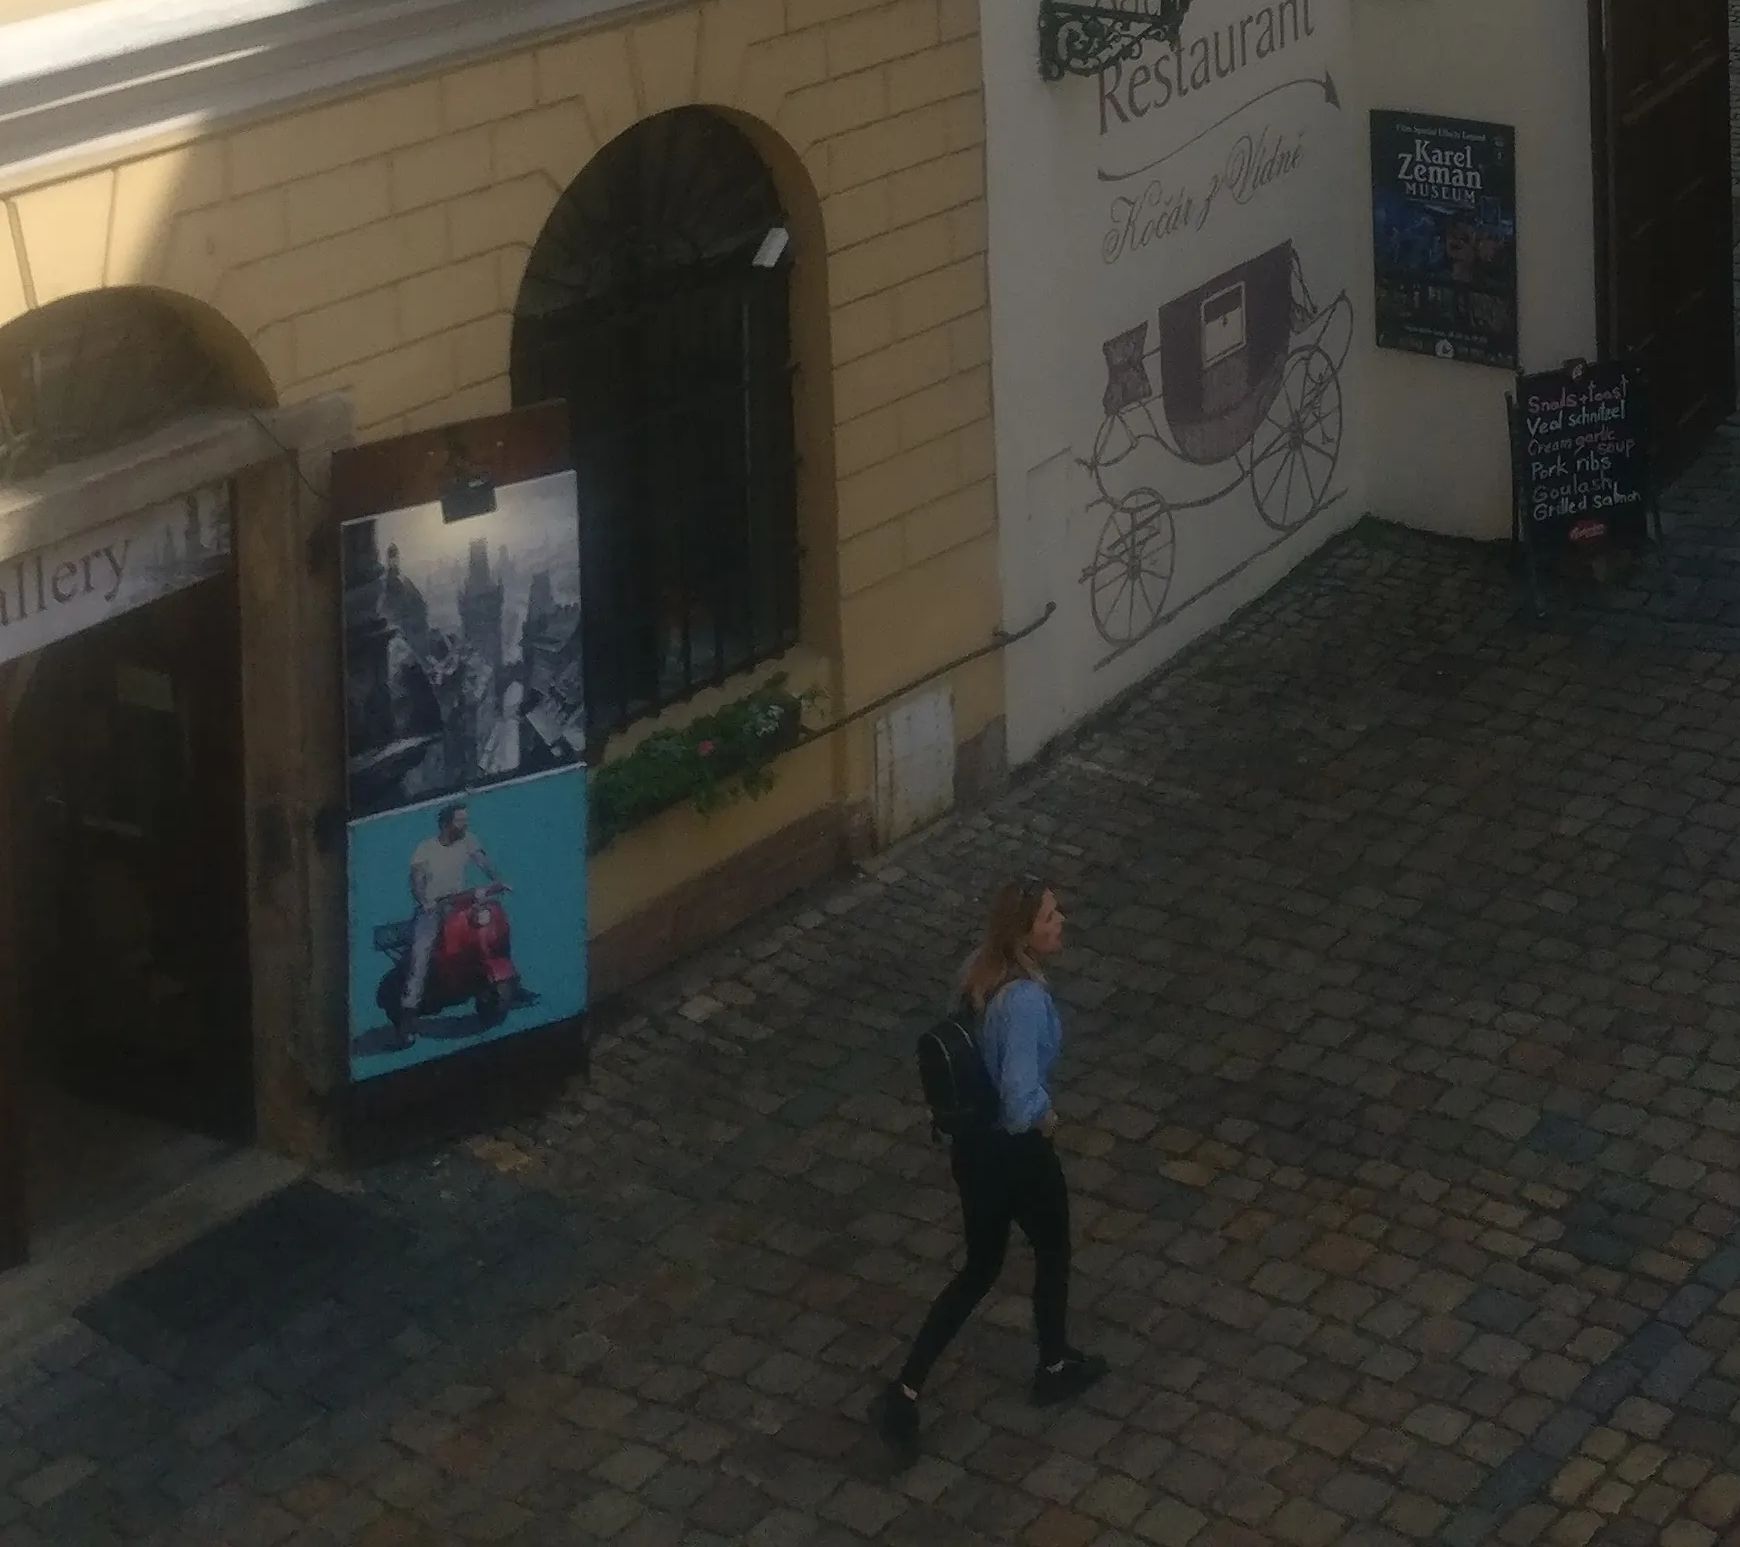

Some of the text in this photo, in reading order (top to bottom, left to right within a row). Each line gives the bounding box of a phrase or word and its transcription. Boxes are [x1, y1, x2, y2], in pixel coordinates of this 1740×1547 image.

[1414, 139, 1473, 168] Karel
[1397, 153, 1483, 190] Zeman
[1404, 182, 1476, 204] MUSEUM
[1526, 399, 1625, 436] Veal schnitzel
[1528, 438, 1572, 456] Cream
[1597, 438, 1636, 458] soup
[1531, 450, 1612, 481] Pork ribs
[1533, 470, 1613, 502] Goulash
[1533, 495, 1587, 521] Grilled
